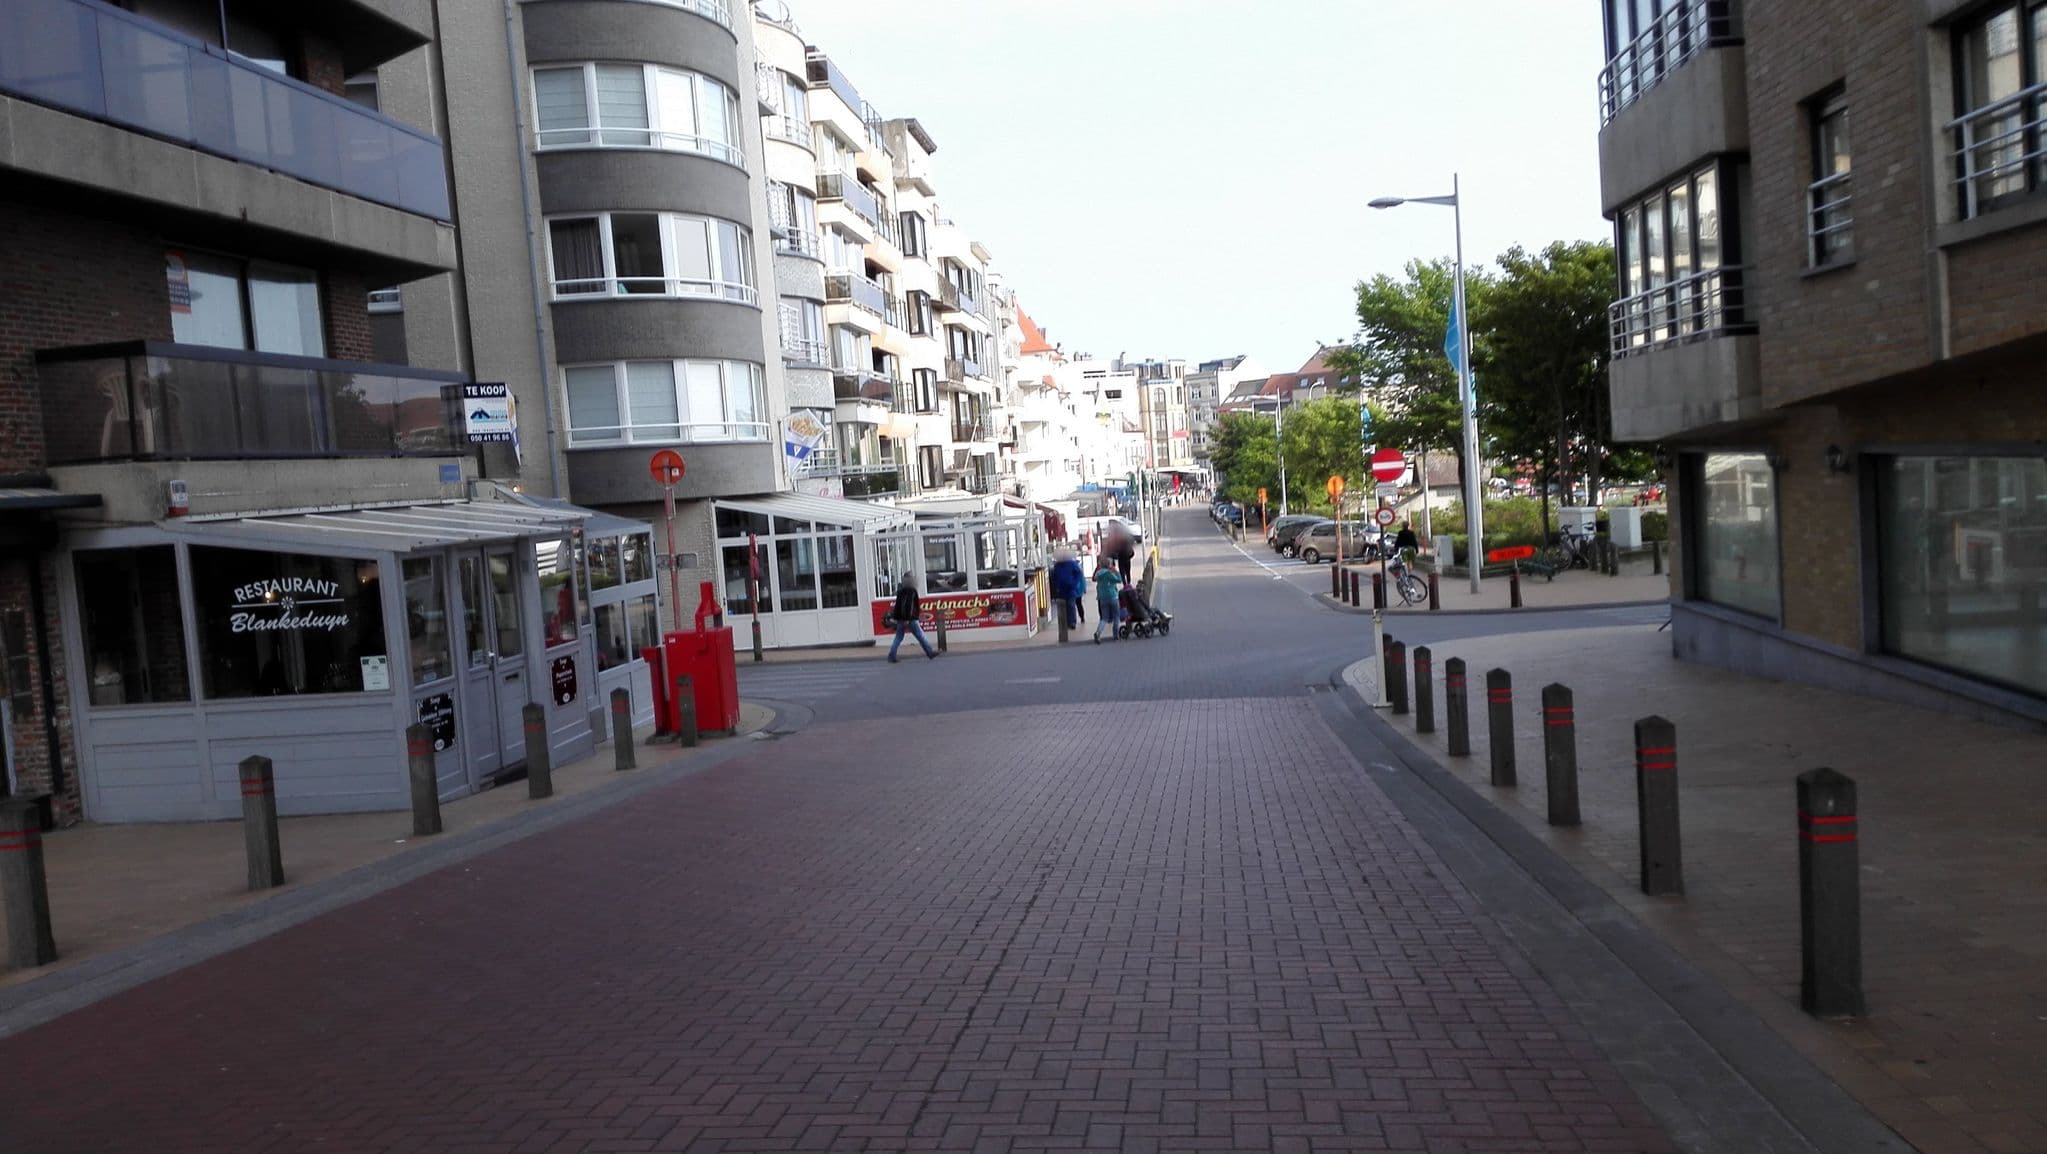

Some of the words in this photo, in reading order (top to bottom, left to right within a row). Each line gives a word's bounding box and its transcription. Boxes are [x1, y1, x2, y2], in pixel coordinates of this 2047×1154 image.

[466, 386, 478, 396] TE
[480, 385, 505, 395] KOOP
[234, 577, 339, 603] RESTAURANT
[919, 596, 990, 611] artsnacks
[230, 610, 350, 632] Blankeduyn
